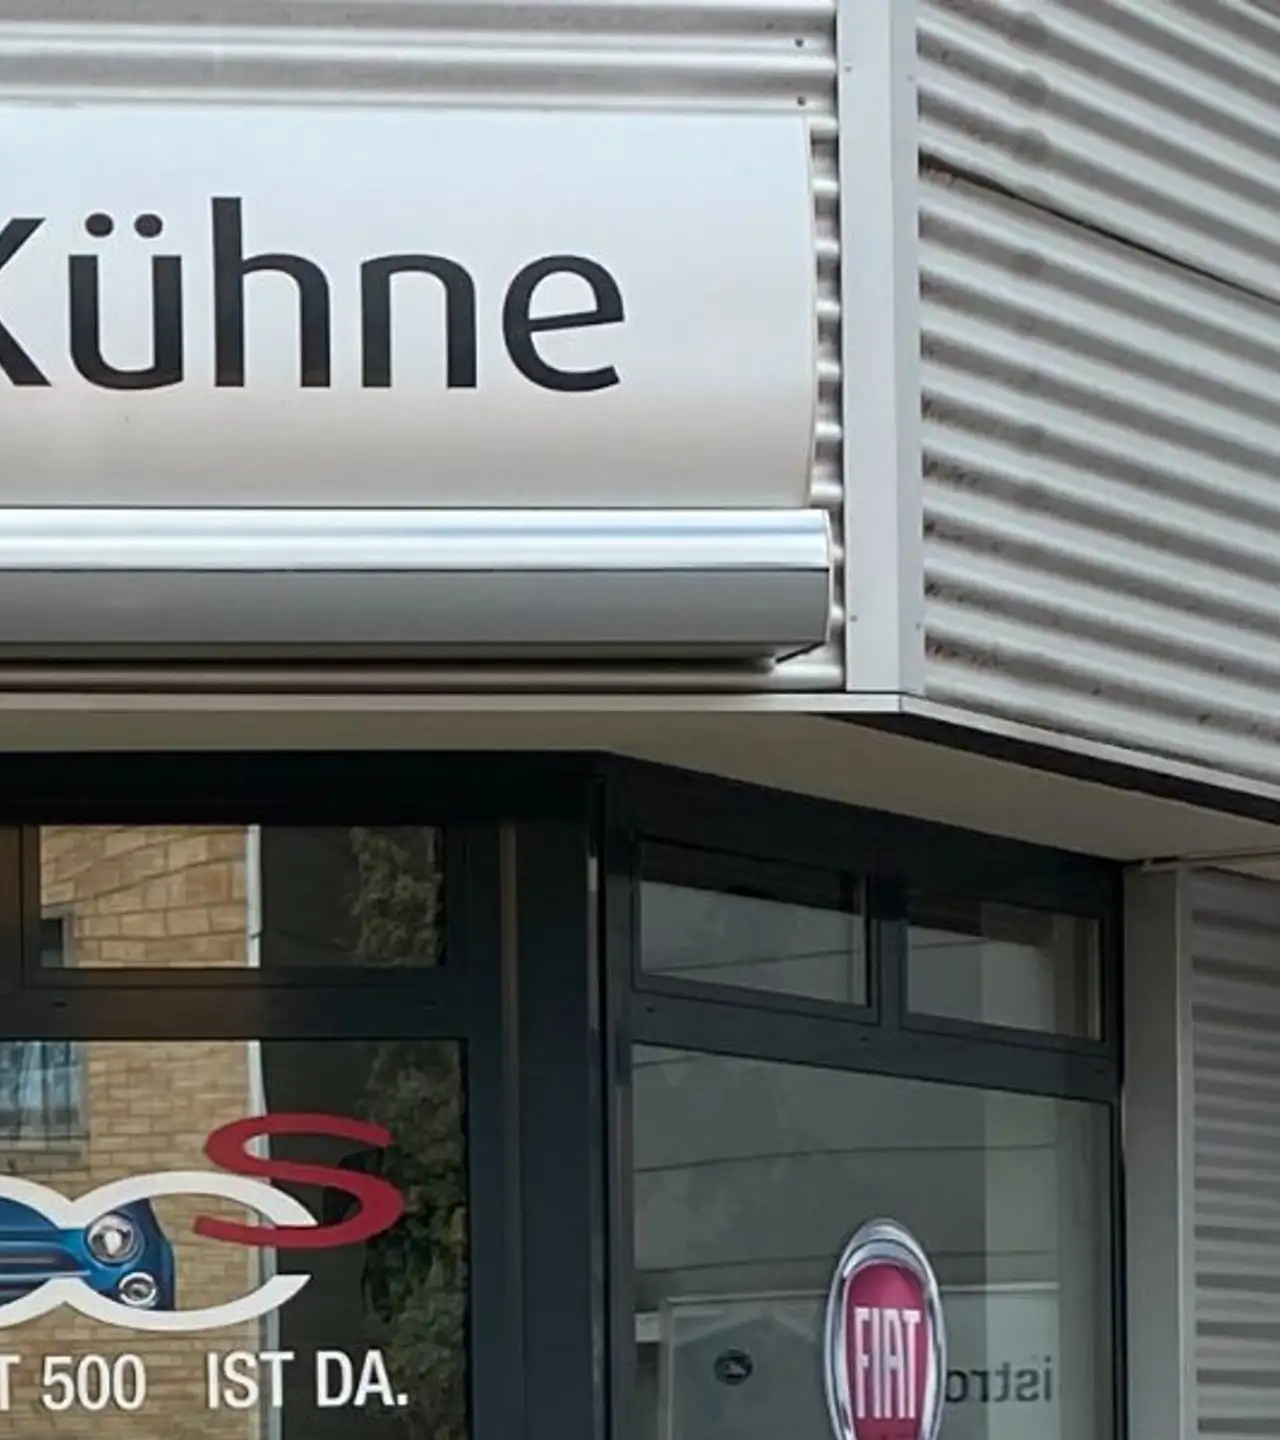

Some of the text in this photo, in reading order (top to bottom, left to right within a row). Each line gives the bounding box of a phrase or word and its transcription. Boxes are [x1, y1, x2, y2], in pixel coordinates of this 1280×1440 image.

[41, 1353, 147, 1411] 500
[206, 1351, 293, 1408] IST
[315, 1349, 409, 1408] DA.
[853, 1304, 922, 1420] FIAT
